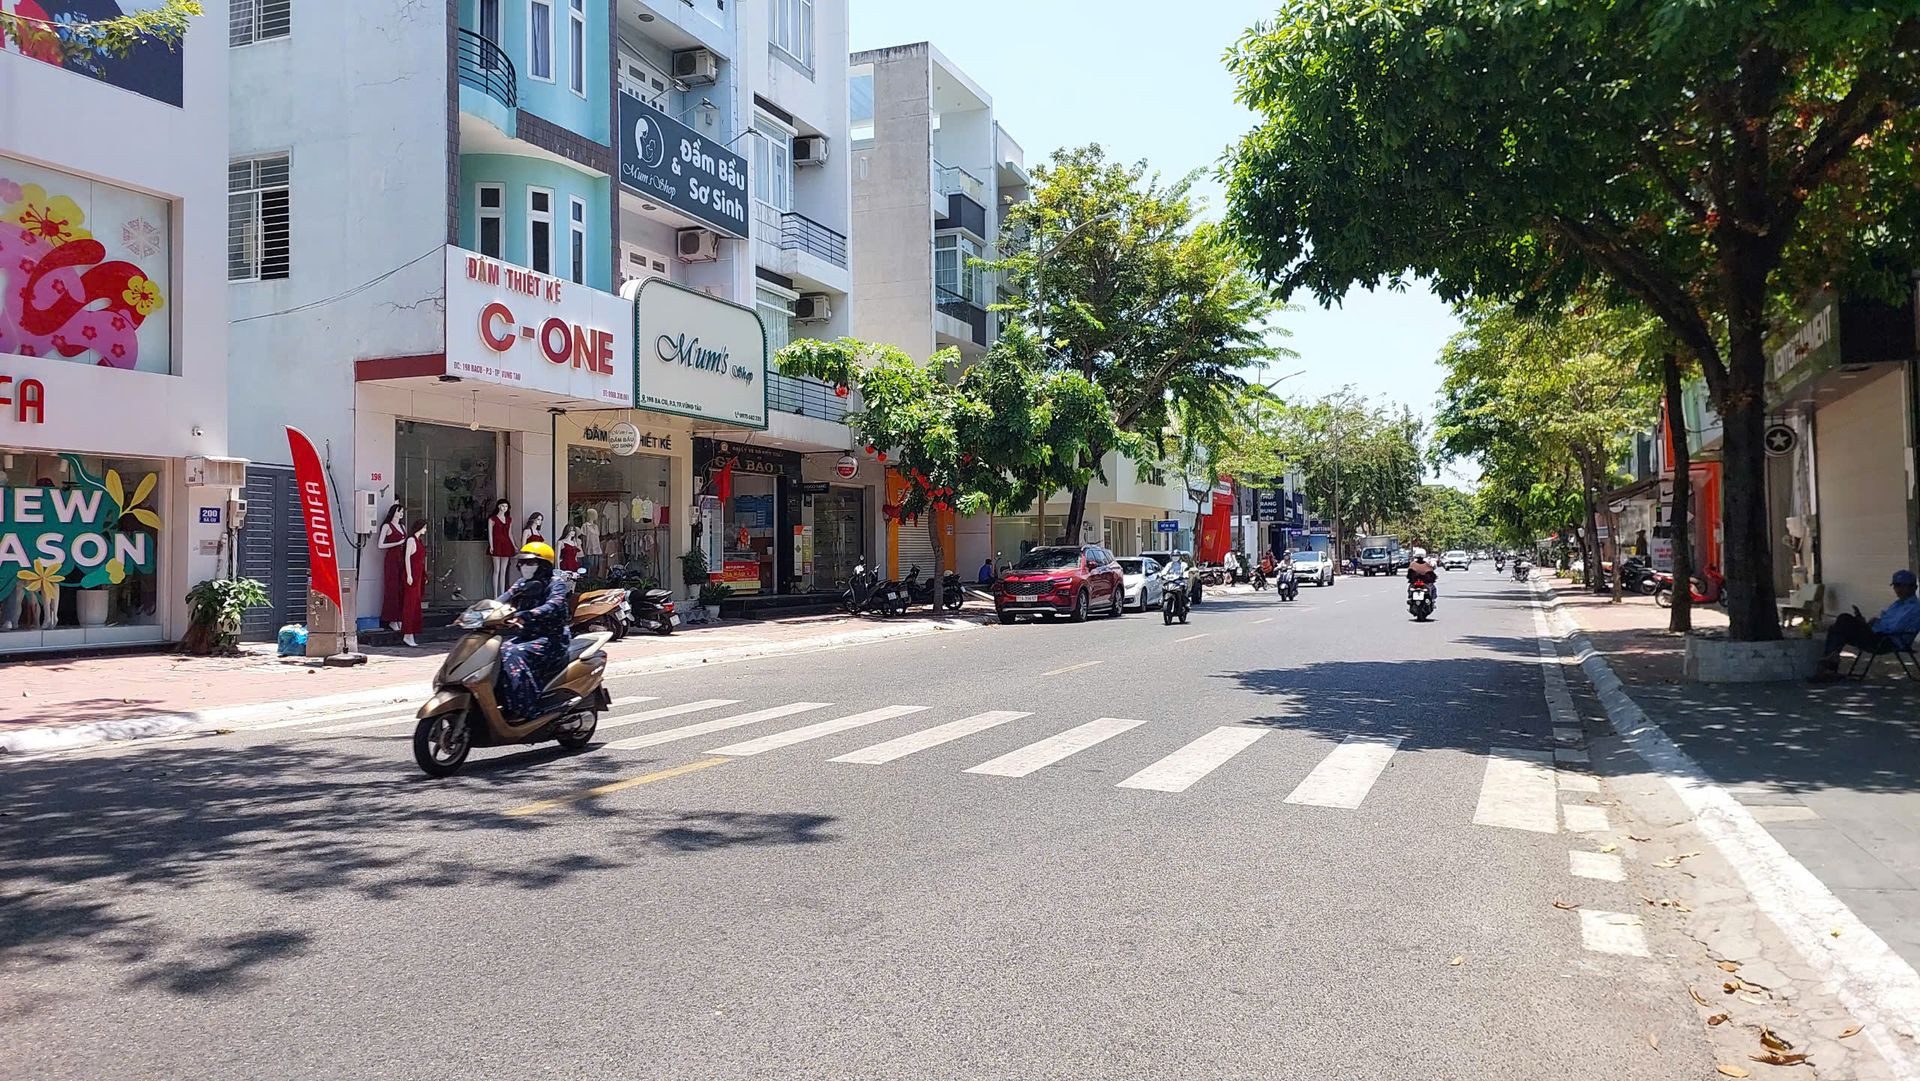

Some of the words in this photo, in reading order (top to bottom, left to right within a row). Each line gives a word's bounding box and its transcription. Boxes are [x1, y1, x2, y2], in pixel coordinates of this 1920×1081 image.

[671, 157, 681, 176] &
[680, 138, 715, 176] Đầm
[718, 157, 745, 191] Bầu
[689, 177, 710, 205] Sơ
[713, 188, 744, 222] Sinh
[479, 302, 614, 376] C-ONE
[655, 332, 729, 375] Mum's
[640, 432, 658, 448] HIẾT
[0, 487, 103, 523] EW
[202, 509, 218, 517] 200
[305, 481, 332, 558] CANIFA
